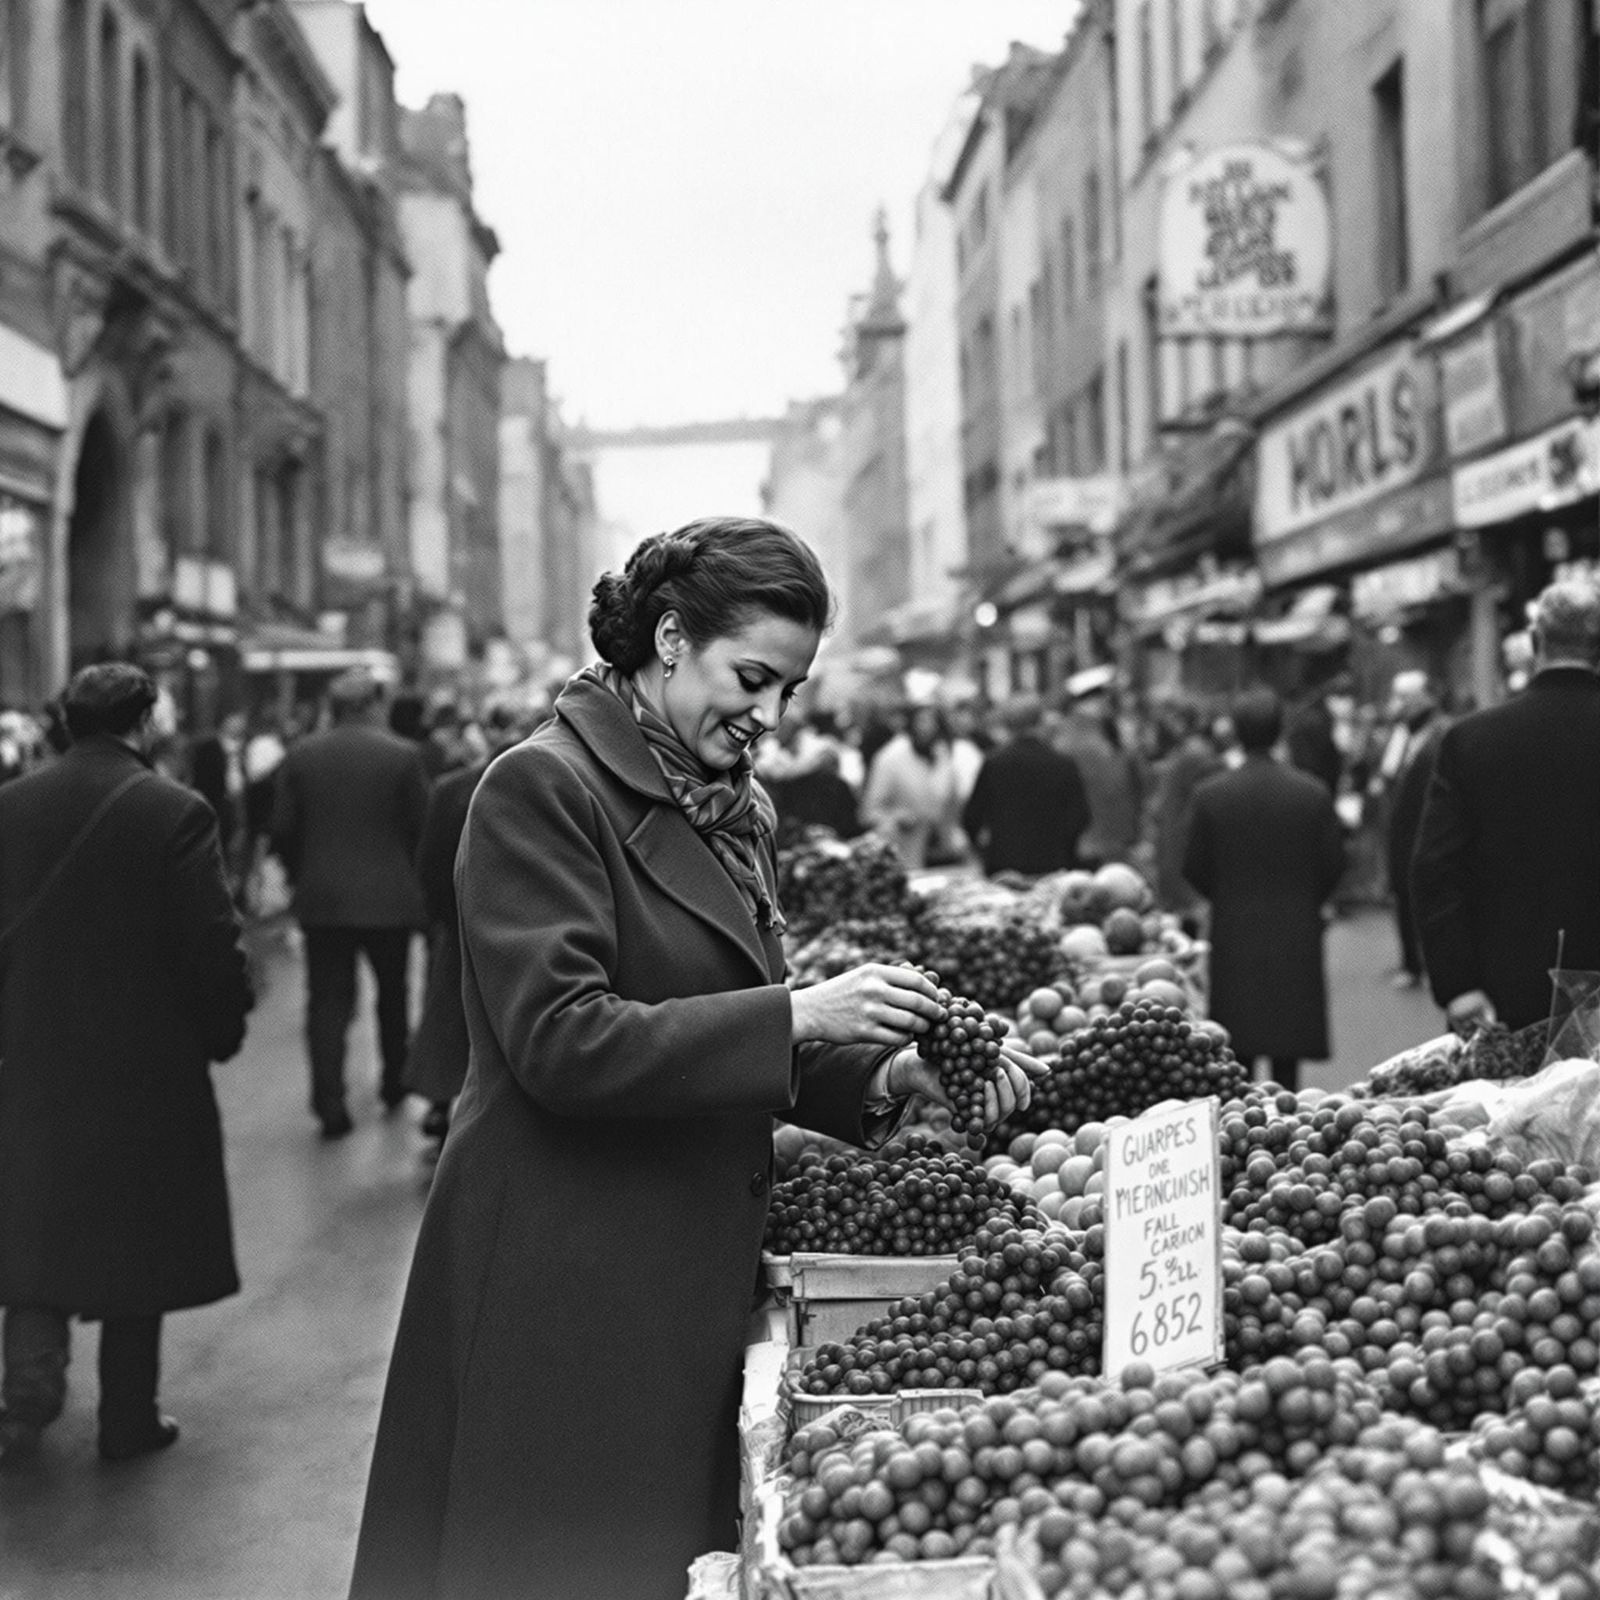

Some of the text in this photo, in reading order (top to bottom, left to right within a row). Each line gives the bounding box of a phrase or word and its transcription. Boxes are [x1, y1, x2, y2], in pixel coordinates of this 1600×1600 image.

[1122, 1117, 1197, 1167] GUARPES
[1148, 1157, 1172, 1180] ONE
[1143, 1212, 1181, 1242] FALL
[1130, 1292, 1204, 1356] 6852
